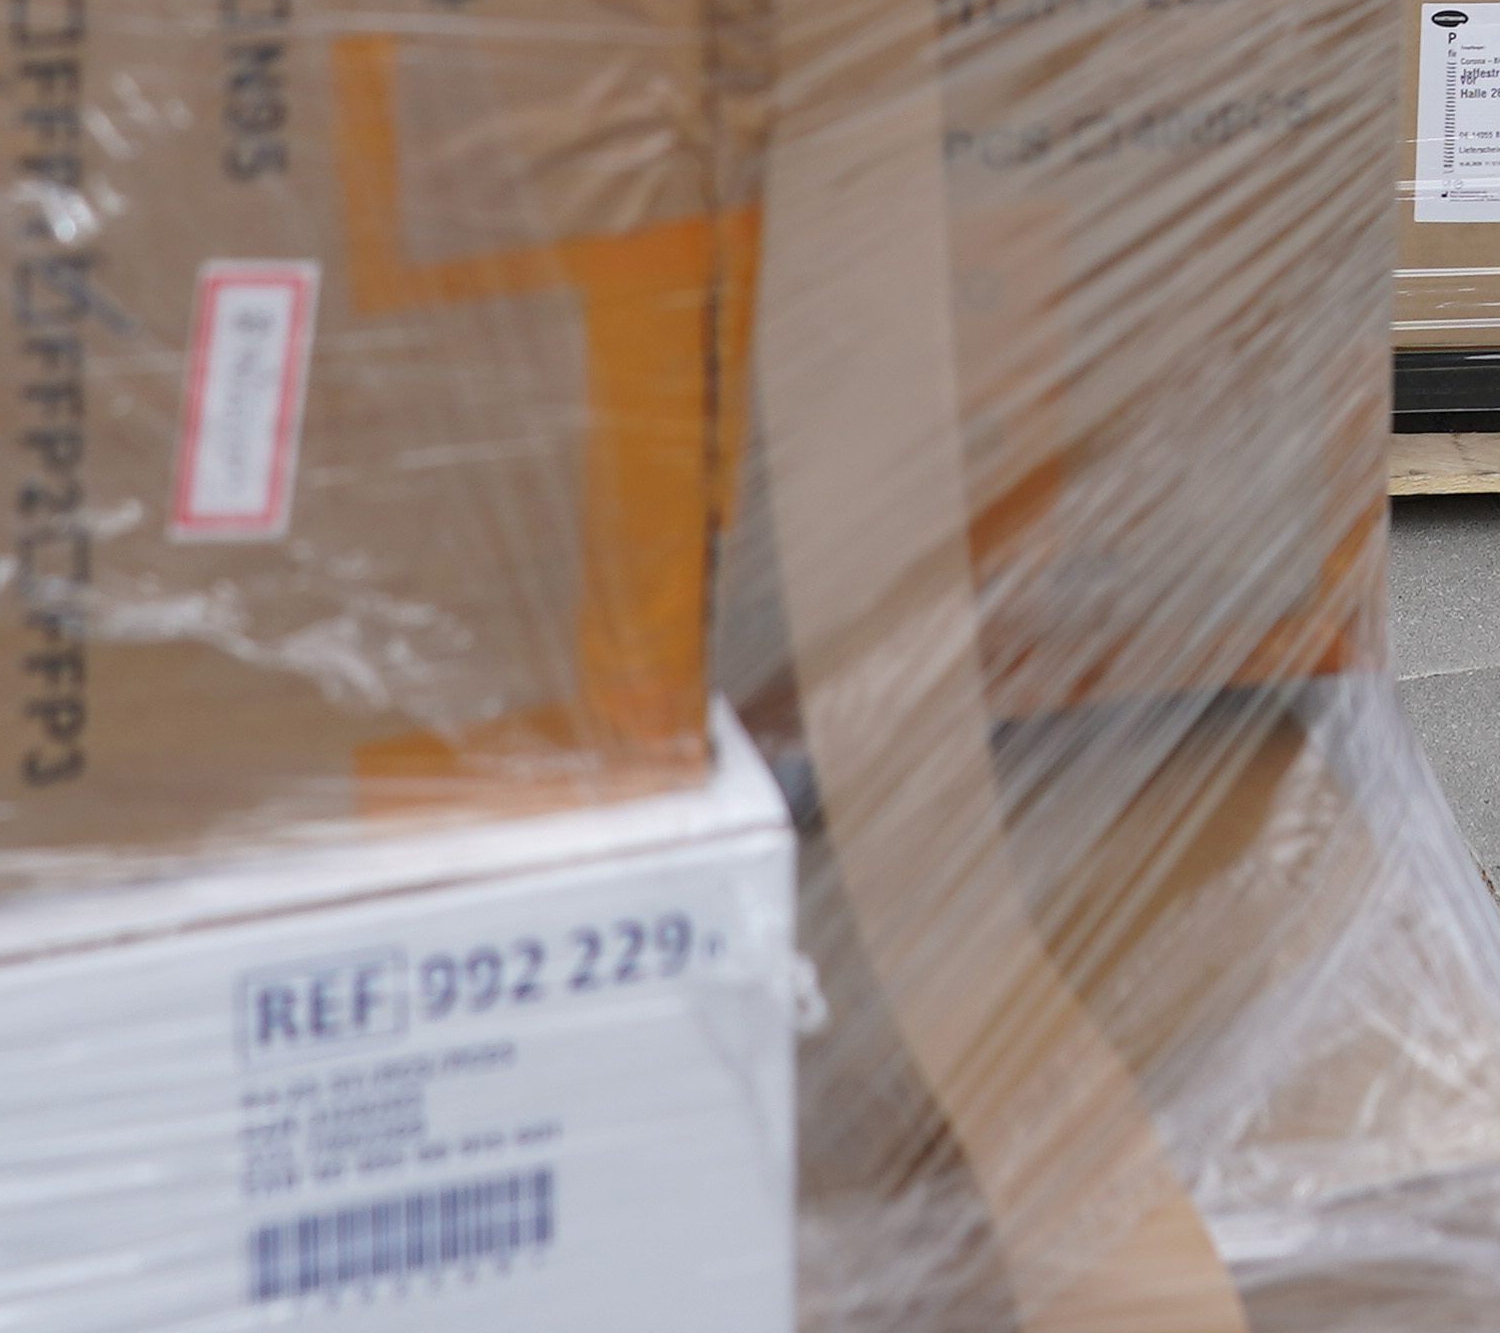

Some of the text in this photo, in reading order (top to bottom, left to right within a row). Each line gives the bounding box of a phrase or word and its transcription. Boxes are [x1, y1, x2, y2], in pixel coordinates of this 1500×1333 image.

[220, 35, 292, 185] N95
[1460, 57, 1486, 66] Corona
[1460, 87, 1488, 100] Halle
[17, 333, 87, 520] FFP2
[255, 910, 695, 1048] REF 992 229
